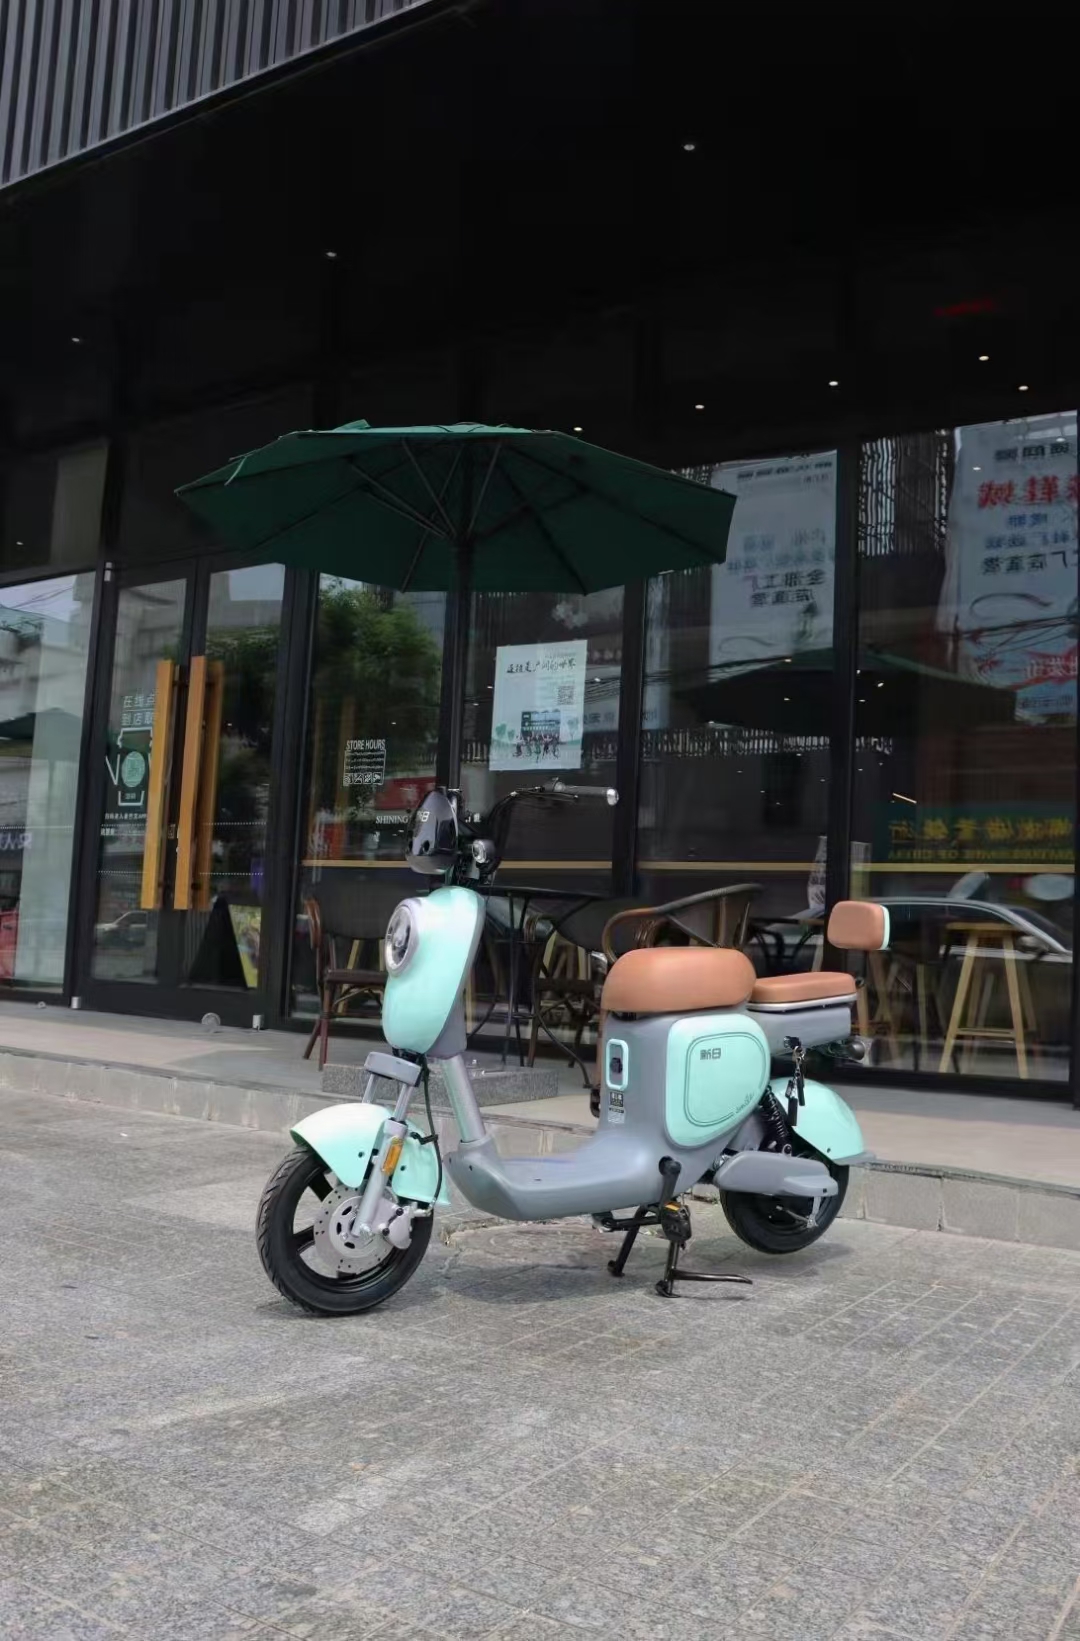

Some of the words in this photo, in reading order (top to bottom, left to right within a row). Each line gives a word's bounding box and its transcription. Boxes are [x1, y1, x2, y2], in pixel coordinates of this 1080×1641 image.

[346, 740, 365, 750] STORE
[365, 739, 386, 750] HOURS
[376, 815, 409, 824] SHINING
[699, 1047, 722, 1060] 新日
